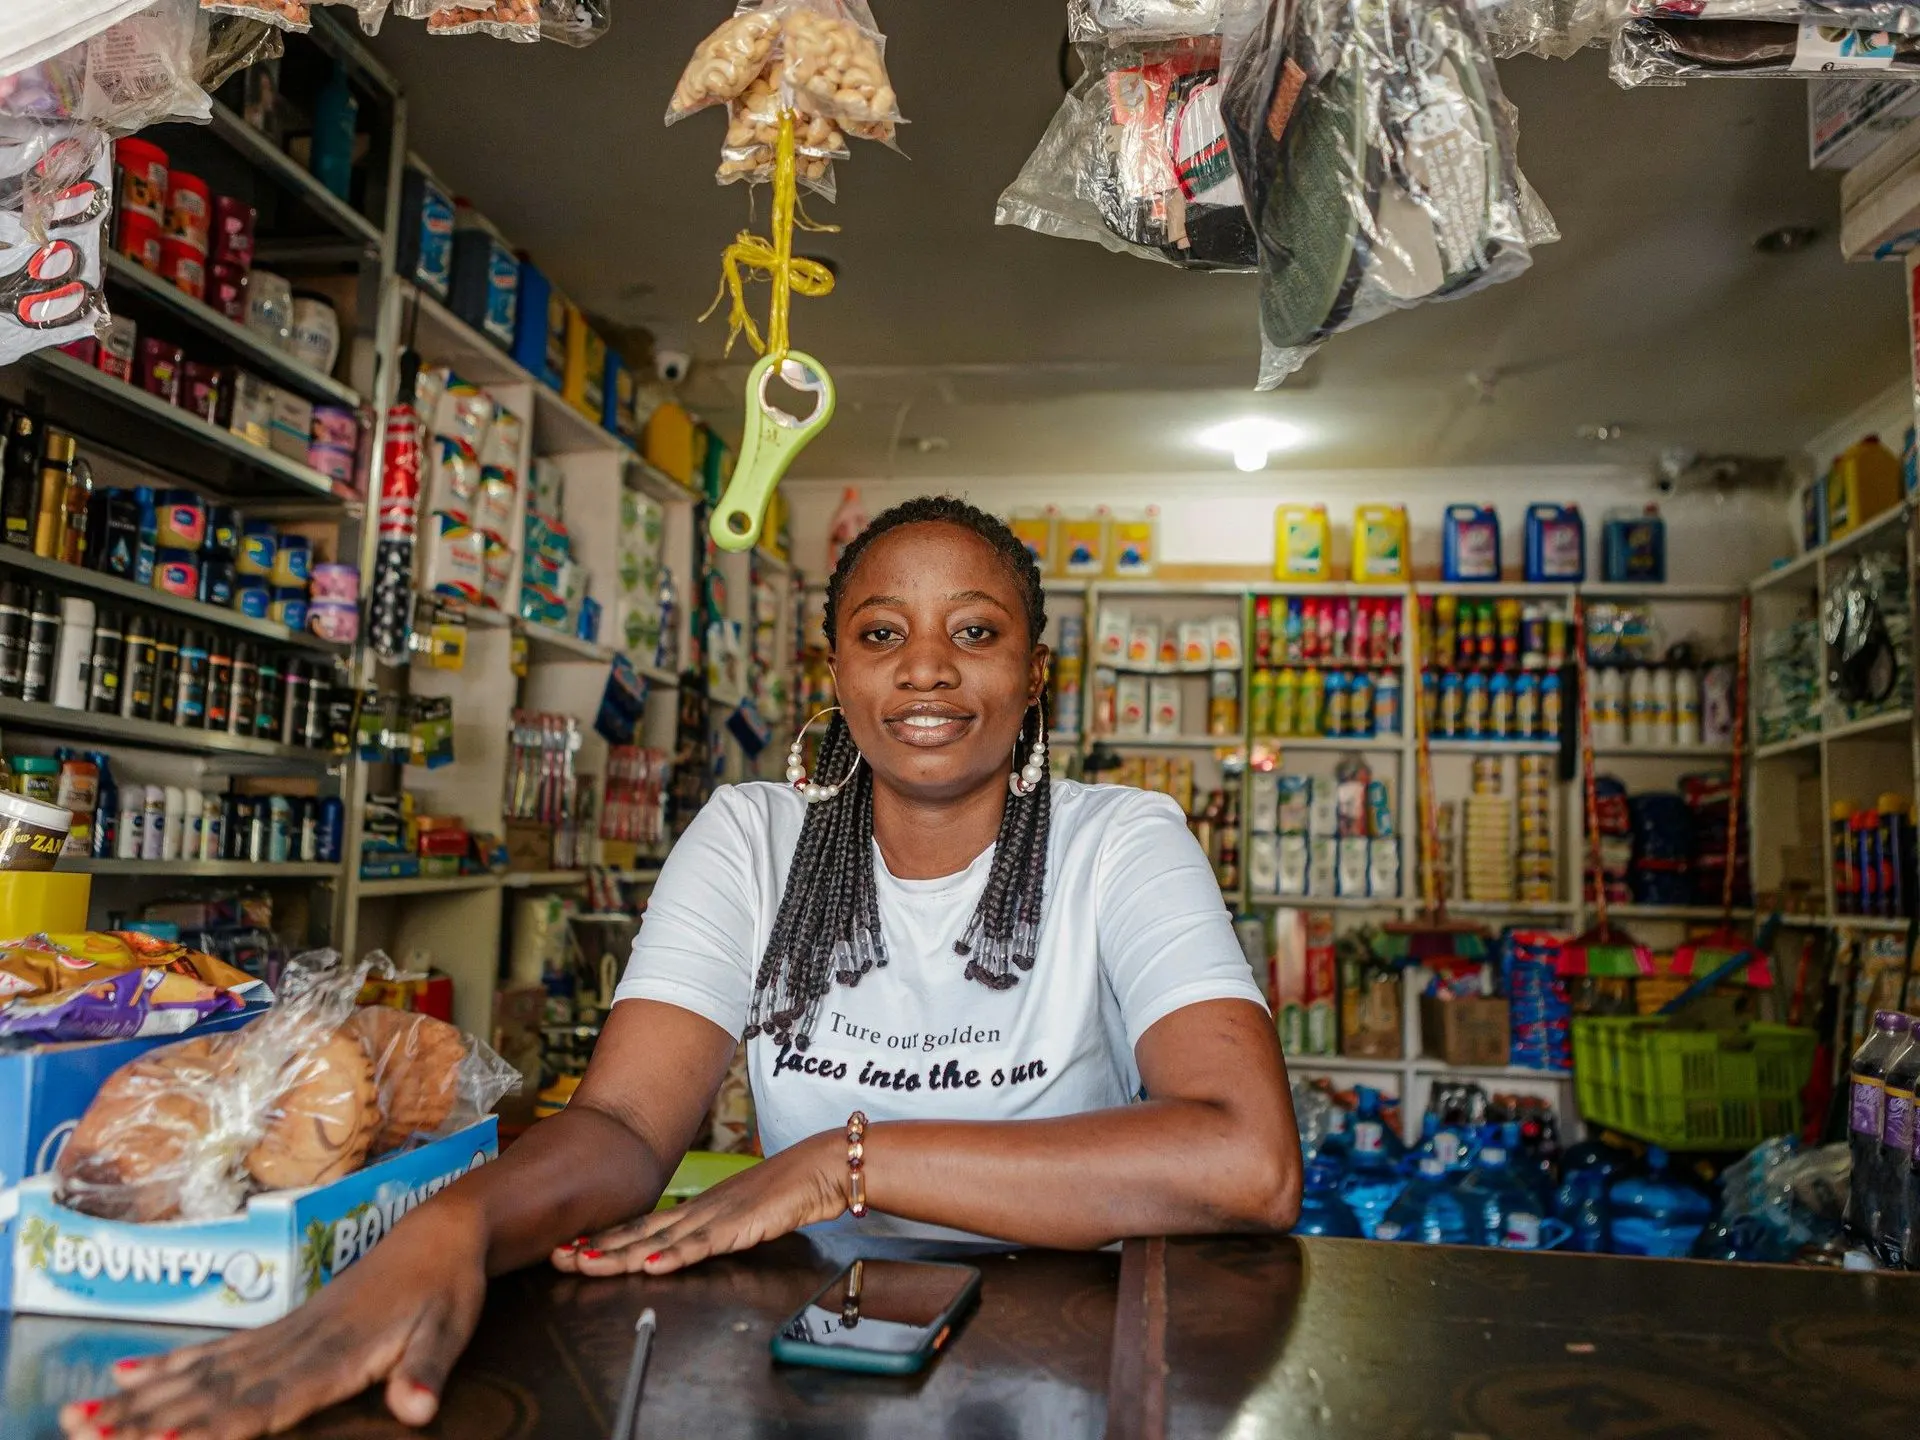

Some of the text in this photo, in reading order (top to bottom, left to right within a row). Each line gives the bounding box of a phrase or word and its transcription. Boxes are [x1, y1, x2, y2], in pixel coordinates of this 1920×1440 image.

[831, 1011, 881, 1044] Ture
[922, 1025, 1001, 1053] golden
[772, 1041, 848, 1080] faces
[858, 1060, 922, 1092] into
[928, 1058, 982, 1091] the
[54, 1233, 215, 1287] BOUNTY
